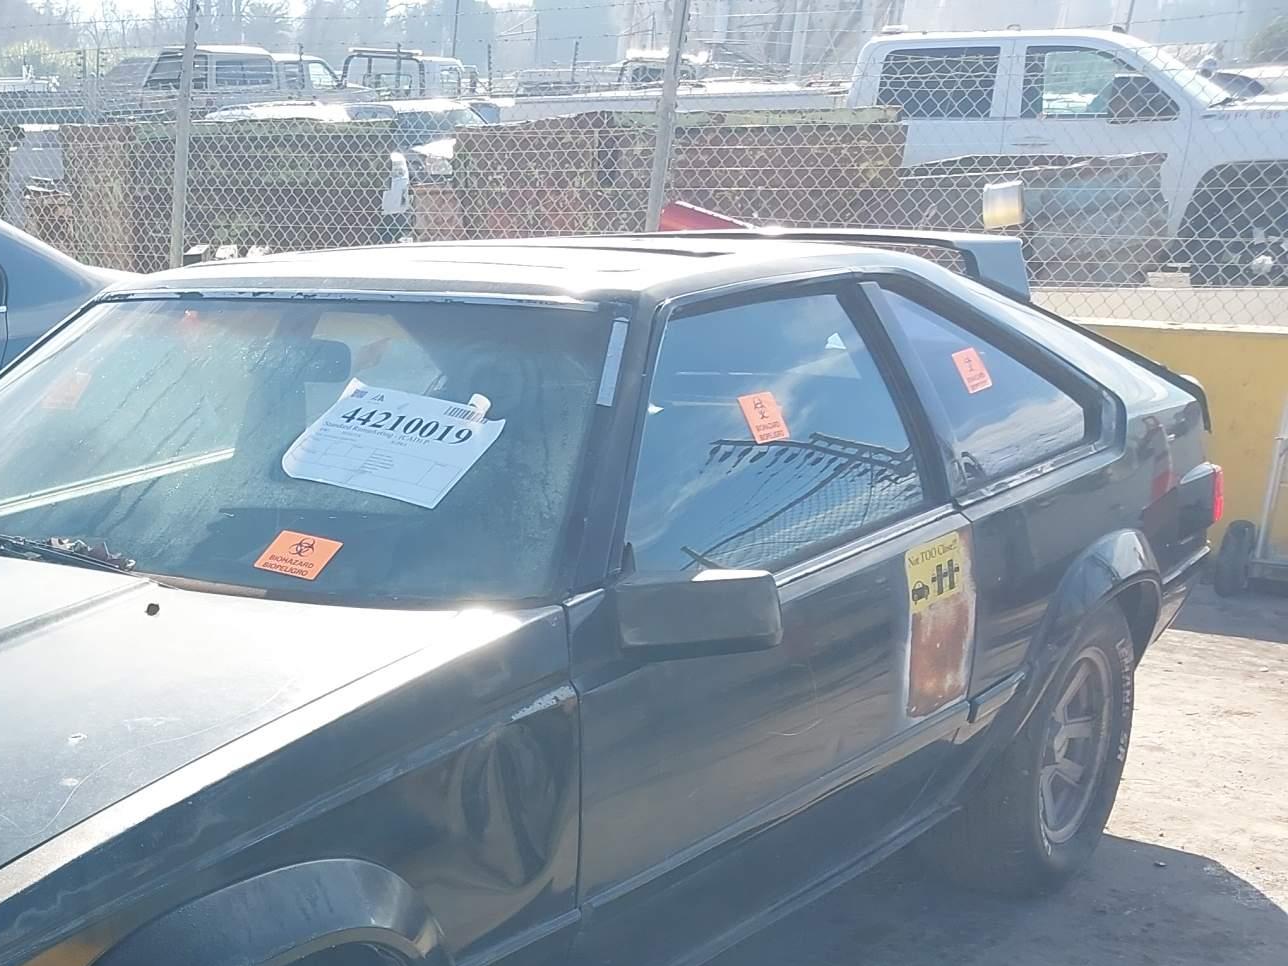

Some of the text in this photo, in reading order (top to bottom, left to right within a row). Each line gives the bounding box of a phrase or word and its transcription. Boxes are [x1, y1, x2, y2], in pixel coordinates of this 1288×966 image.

[341, 407, 473, 445] 44210019
[262, 562, 309, 576] BIOPELIGRO
[269, 554, 314, 569] BIOHAZARD
